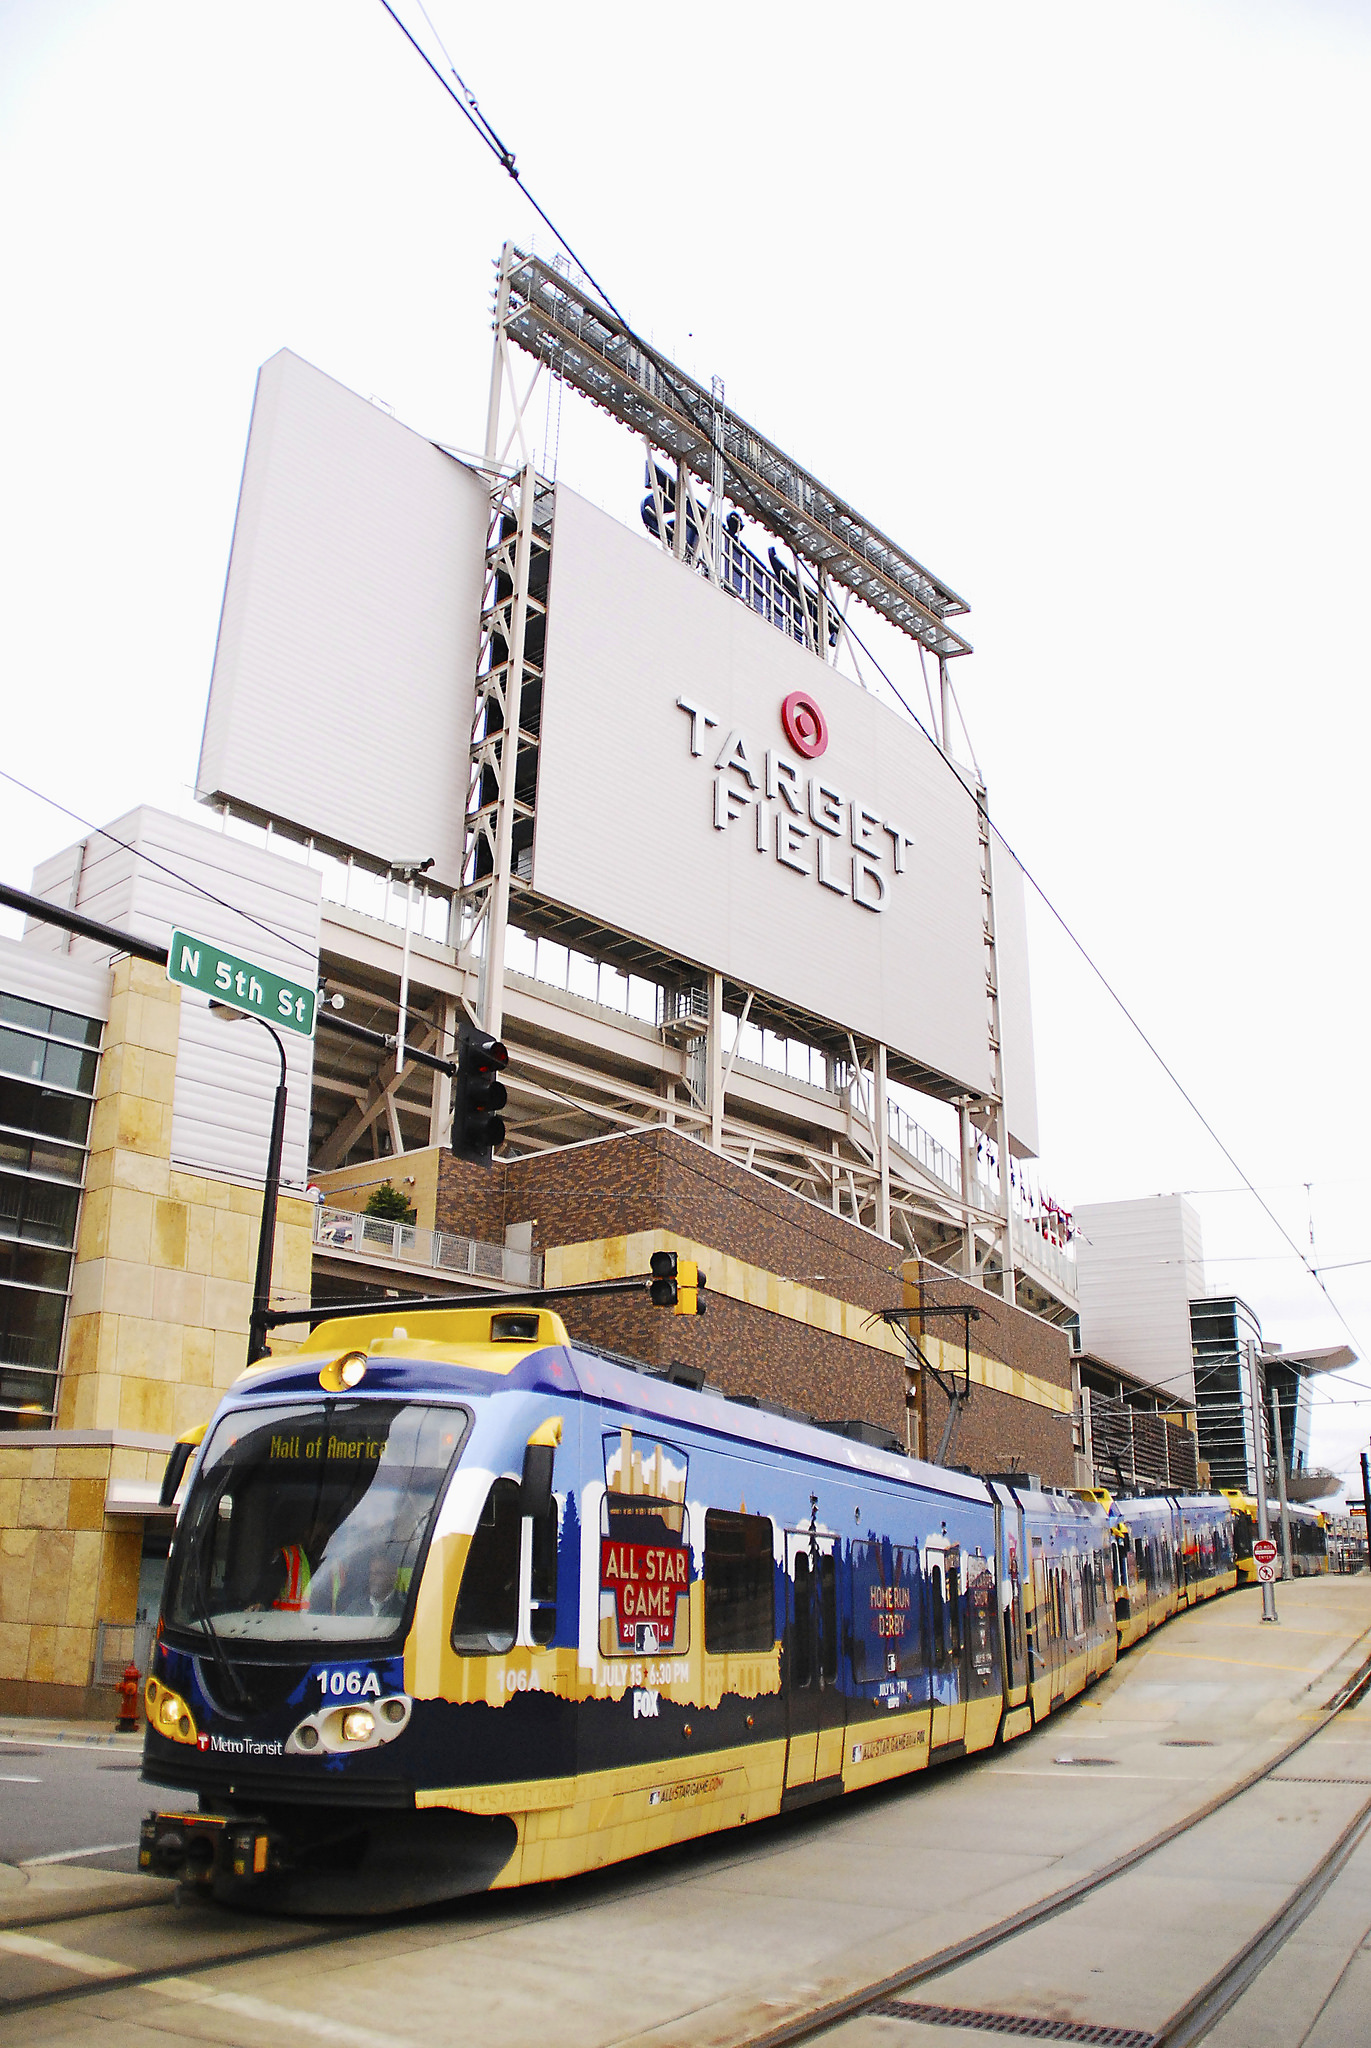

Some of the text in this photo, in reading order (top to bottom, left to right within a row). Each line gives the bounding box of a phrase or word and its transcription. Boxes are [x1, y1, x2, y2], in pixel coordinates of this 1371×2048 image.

[676, 695, 915, 874] TARGET
[713, 776, 891, 913] FIELD
[180, 945, 306, 1023] N 5th St
[270, 1435, 299, 1459] Mall
[305, 1436, 322, 1459] of
[606, 1547, 686, 1583] ALL STAR
[623, 1584, 671, 1616] GAME
[870, 1585, 910, 1608] HOME RUN
[879, 1615, 905, 1636] DERBY
[317, 1671, 380, 1696] 106A
[497, 1669, 540, 1692] 106A
[600, 1662, 689, 1687] JULY 15 6:30 PM
[633, 1690, 659, 1719] FOX
